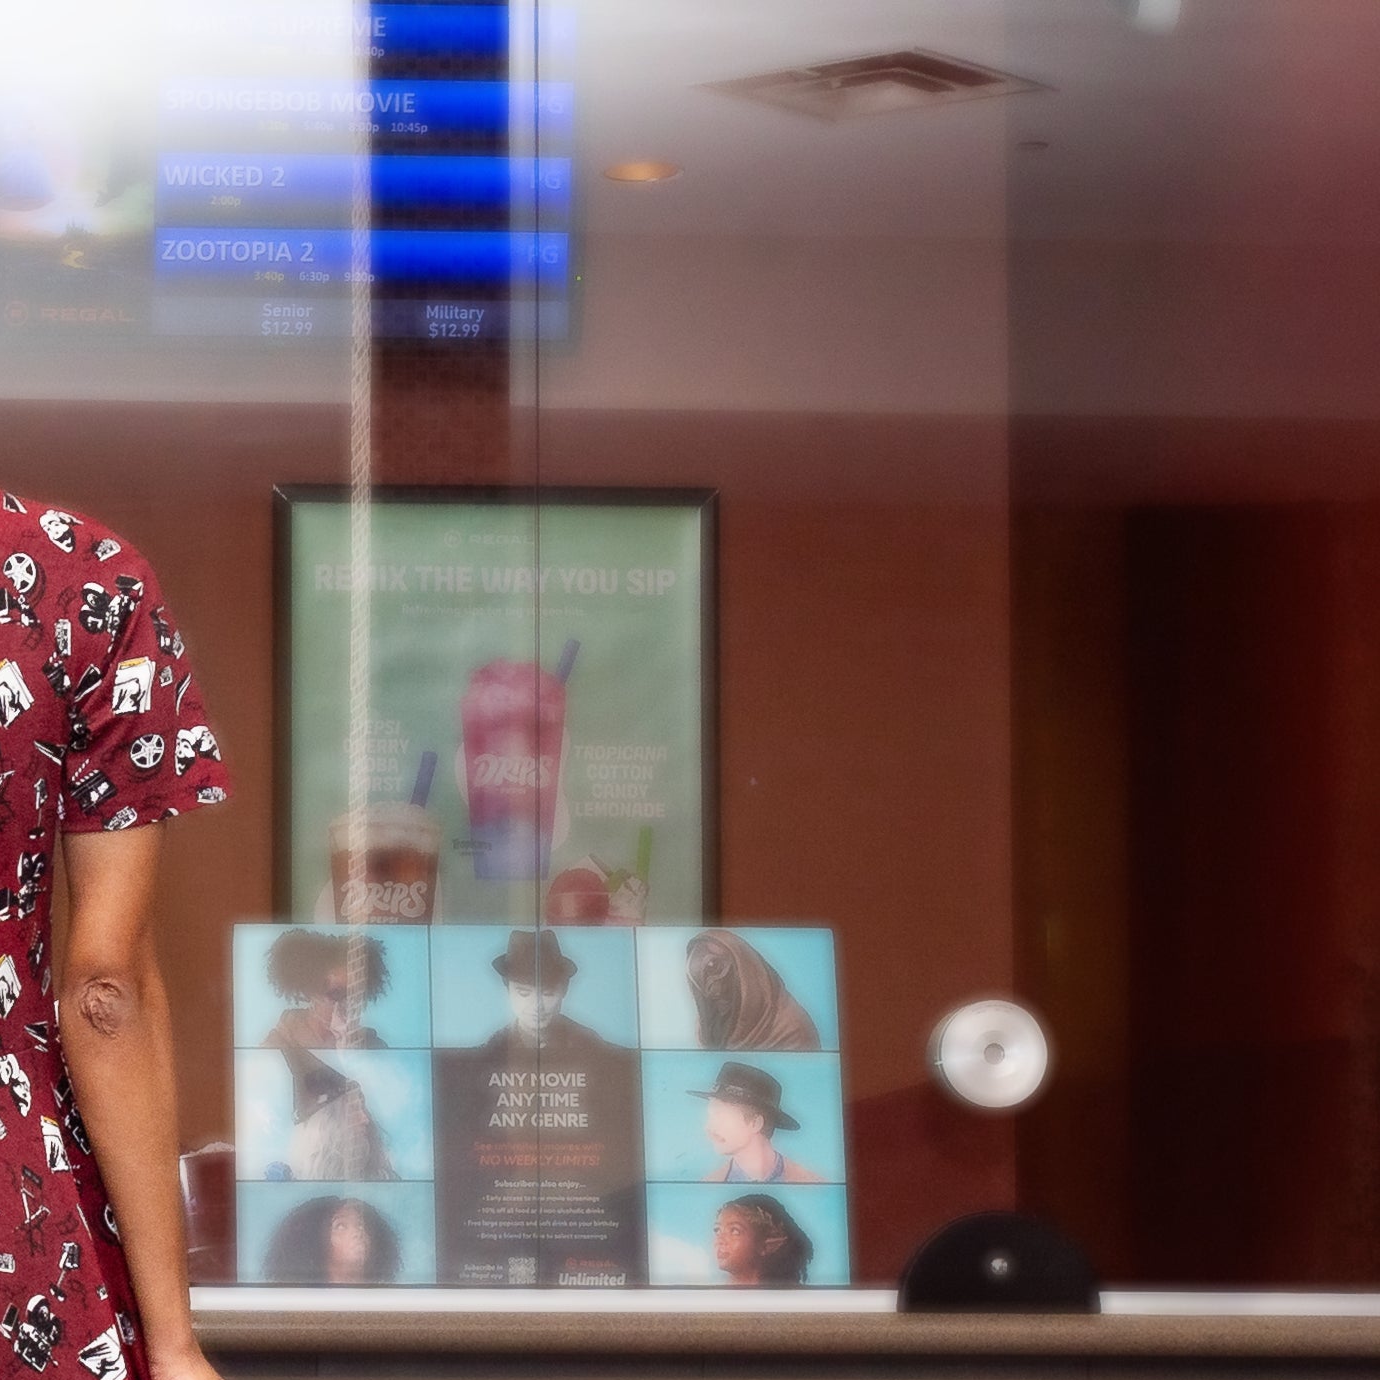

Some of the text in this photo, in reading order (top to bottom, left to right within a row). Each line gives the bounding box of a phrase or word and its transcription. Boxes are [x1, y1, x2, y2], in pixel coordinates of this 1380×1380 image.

[164, 89, 417, 114] SPONGEBOB MOVIE
[390, 121, 428, 135] 10:45p
[164, 165, 286, 188] WICKED 2
[160, 240, 315, 263] ZOOTOPIA 2
[253, 271, 285, 284] 3:40p
[298, 271, 330, 284] 6:30p
[262, 303, 314, 318] Senior
[426, 303, 485, 323] Military
[261, 319, 314, 337] $12.99
[428, 322, 480, 339] $12.99
[415, 564, 474, 593] THE
[481, 565, 551, 595] WAY
[559, 567, 618, 596] YOU
[626, 567, 676, 597] SIP
[574, 745, 668, 762] TROPICANA
[586, 765, 654, 781] COTTON
[591, 783, 649, 800] CANDY
[573, 802, 667, 819] LEMONADE
[488, 1072, 587, 1088] ANY MOVIE
[496, 1092, 580, 1108] ANY TIME
[488, 1112, 589, 1128] ANY GENRE
[480, 1155, 501, 1166] NO
[556, 1155, 600, 1166] LIMITS!
[558, 1272, 627, 1287] Unlimited
